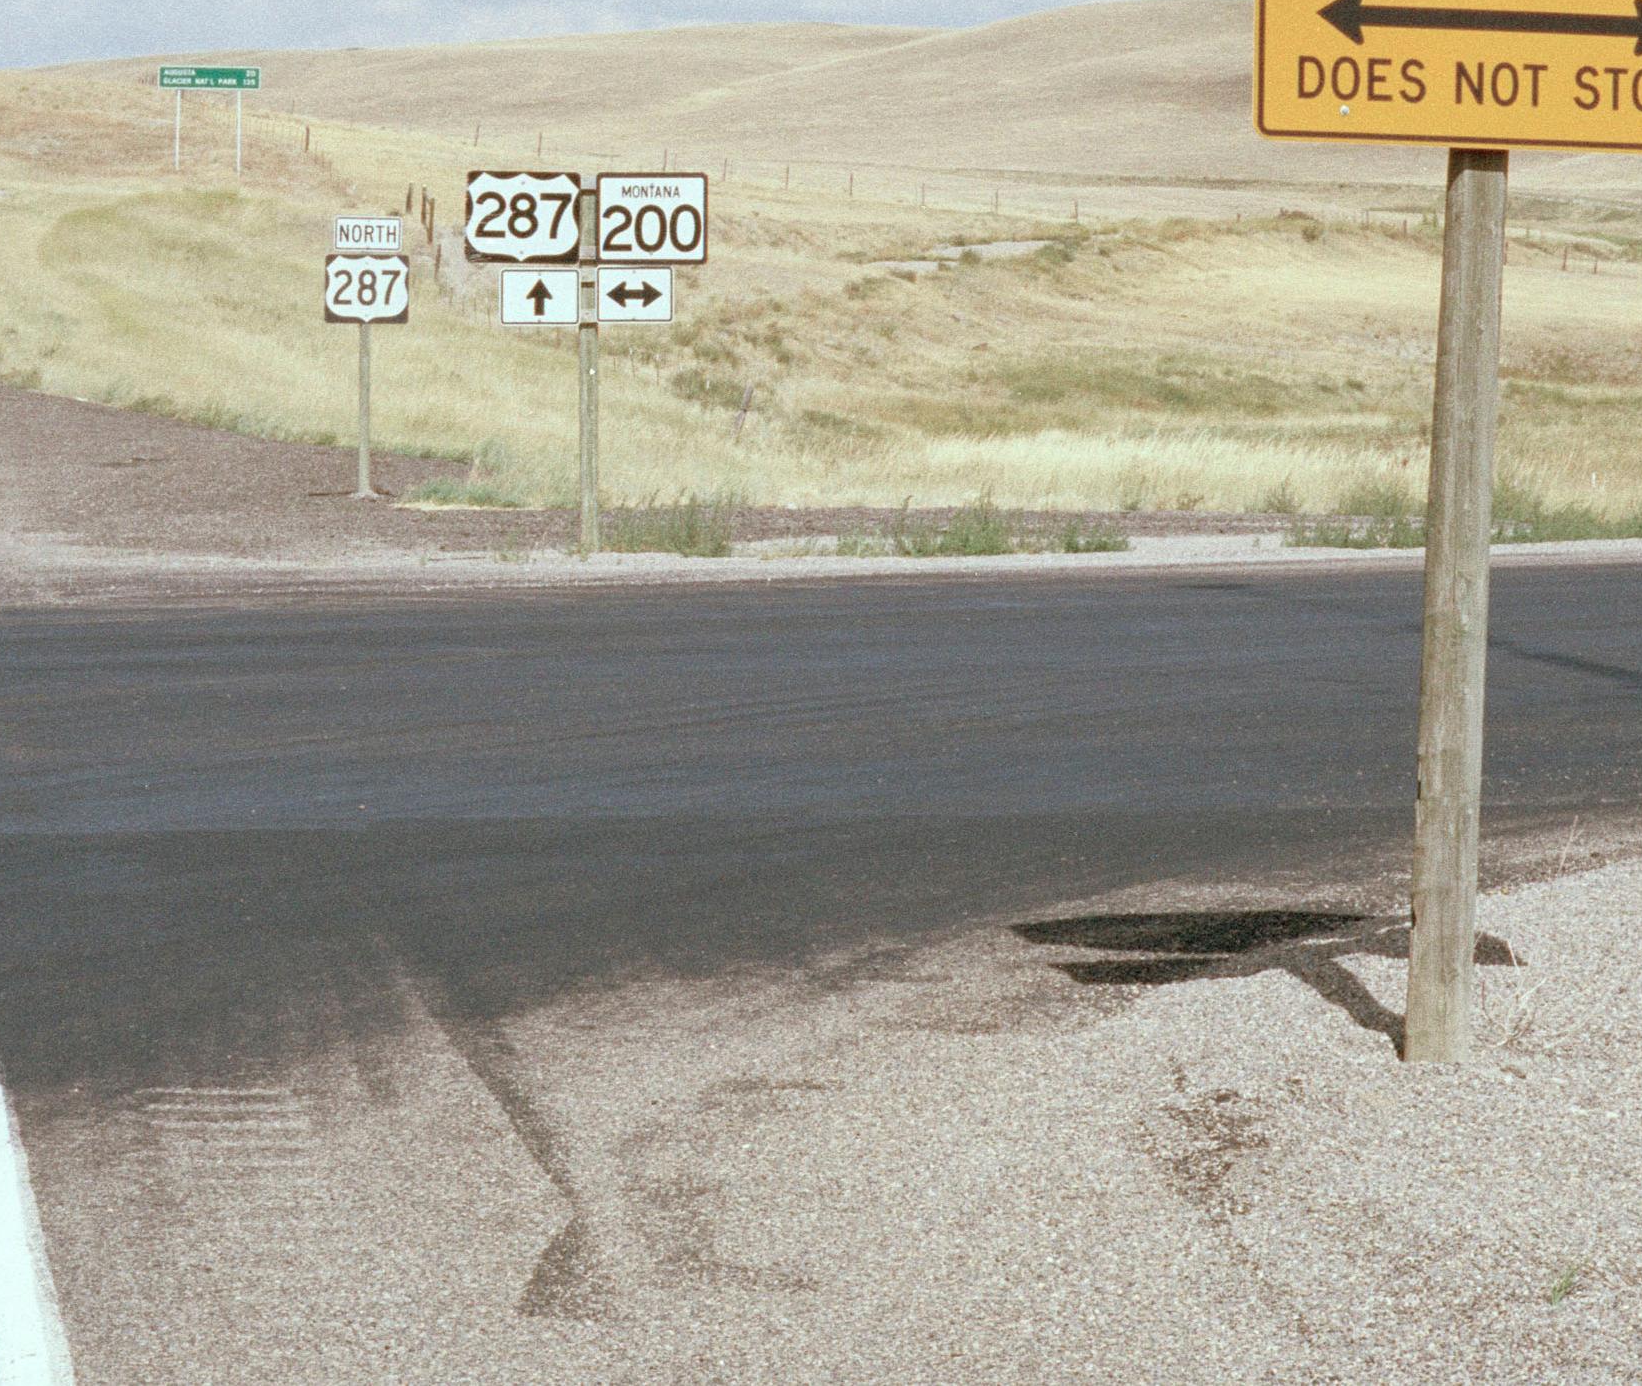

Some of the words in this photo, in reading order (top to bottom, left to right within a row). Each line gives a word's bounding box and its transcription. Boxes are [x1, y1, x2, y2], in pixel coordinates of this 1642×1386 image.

[163, 77, 192, 85] GLACIER
[218, 78, 237, 86] PARK
[1297, 55, 1427, 105] DOES
[1454, 60, 1549, 108] NOT
[621, 184, 681, 199] MONTANA
[338, 219, 398, 243] NORTH
[474, 191, 573, 240] 287
[602, 203, 702, 253] 200
[332, 269, 401, 306] 287
